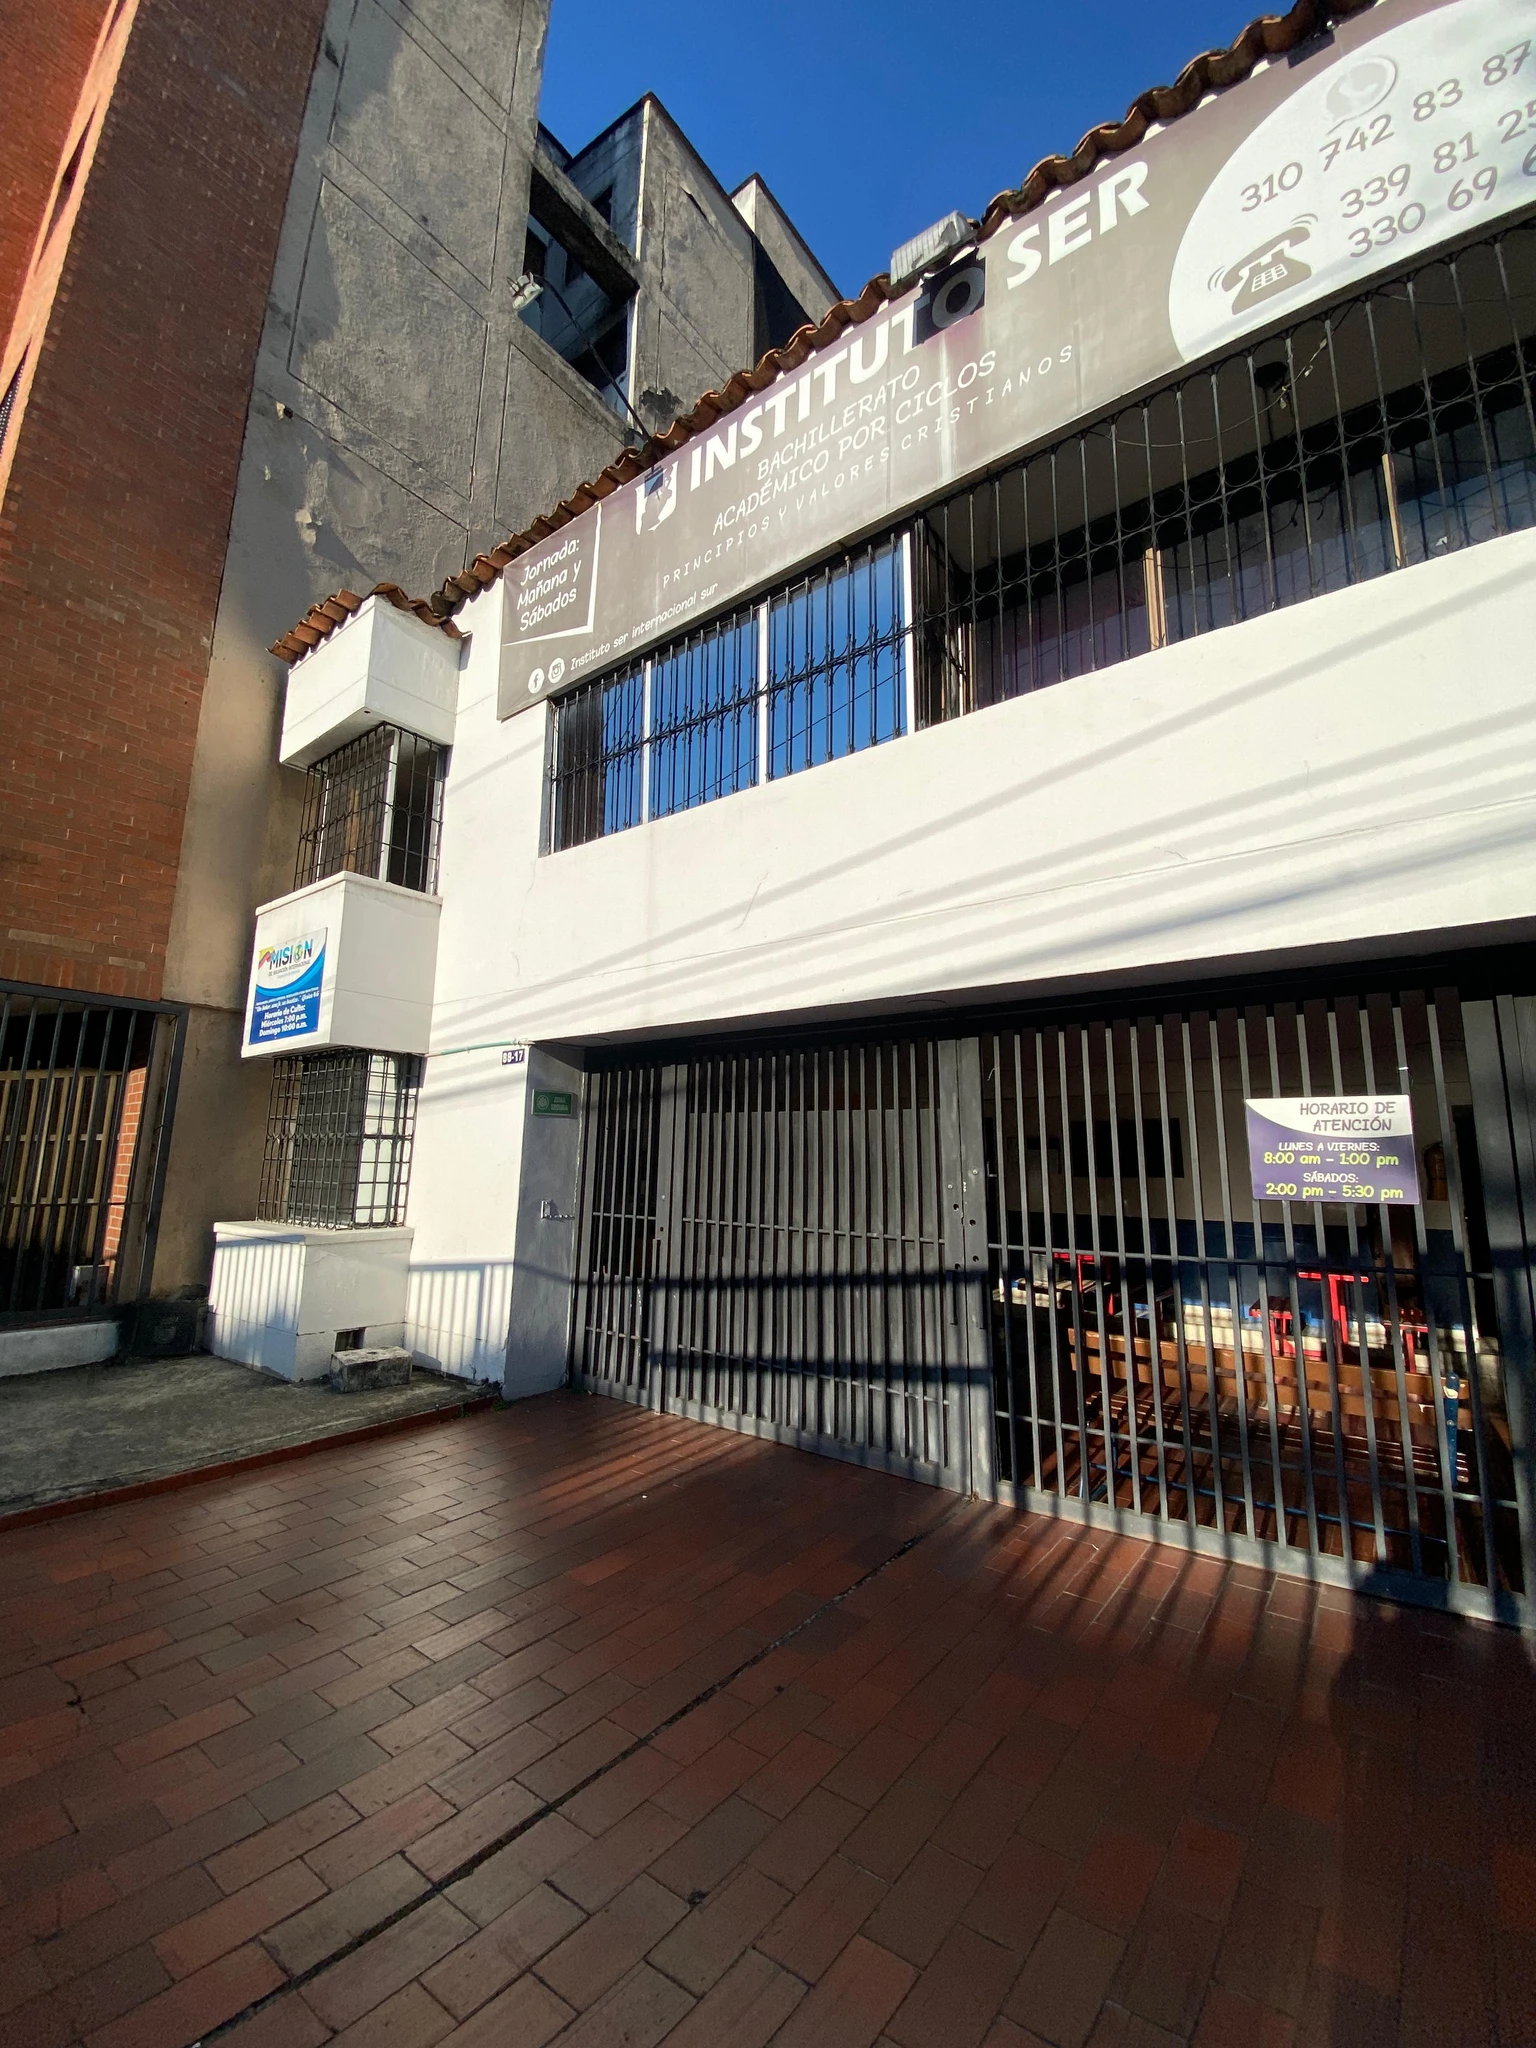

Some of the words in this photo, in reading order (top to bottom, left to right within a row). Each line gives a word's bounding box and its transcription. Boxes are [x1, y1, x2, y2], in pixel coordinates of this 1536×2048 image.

[1240, 161, 1302, 212] 310
[1319, 114, 1394, 171] 742
[1413, 78, 1464, 122] 83
[1482, 40, 1532, 87] 87
[1340, 164, 1411, 218] 339
[1434, 132, 1479, 173] 81
[1348, 202, 1426, 258] 330
[1447, 166, 1498, 211] 69
[690, 266, 985, 491] INSTITUTO
[1007, 161, 1150, 290] SER
[713, 457, 828, 535] ACADÉMICO
[838, 420, 886, 466] POR
[896, 349, 996, 425] CICLOS
[758, 365, 920, 481] BACHILLERATO
[662, 516, 770, 588] PRINCIPIOS
[778, 503, 787, 521] Y
[796, 446, 889, 512] VALORES
[901, 344, 1073, 449] CRISTIANOS
[517, 573, 568, 610] Mañana
[573, 559, 582, 583] y
[520, 538, 580, 586] Jornada:
[519, 588, 577, 632] Sábados
[570, 641, 611, 671] Instituto
[613, 632, 629, 649] ser
[631, 595, 697, 640] internacional
[700, 582, 719, 601] sur
[1300, 1102, 1368, 1115] HORARIO
[1375, 1101, 1396, 1114] DE
[1313, 1116, 1392, 1132] ATENCIÓN
[1263, 1152, 1294, 1164] 8:00
[1300, 1154, 1320, 1164] am
[1339, 1153, 1370, 1165] 1:00
[1376, 1155, 1399, 1168] pm
[1278, 1142, 1313, 1151] LUNES
[1317, 1142, 1324, 1151] A
[1327, 1142, 1380, 1151] VIERNES:
[1266, 1183, 1297, 1195] 2:00
[1302, 1186, 1323, 1199] pm
[1342, 1185, 1374, 1198] 5:30
[1381, 1187, 1403, 1201] pm
[1303, 1171, 1359, 1183] SÁBADOS:
